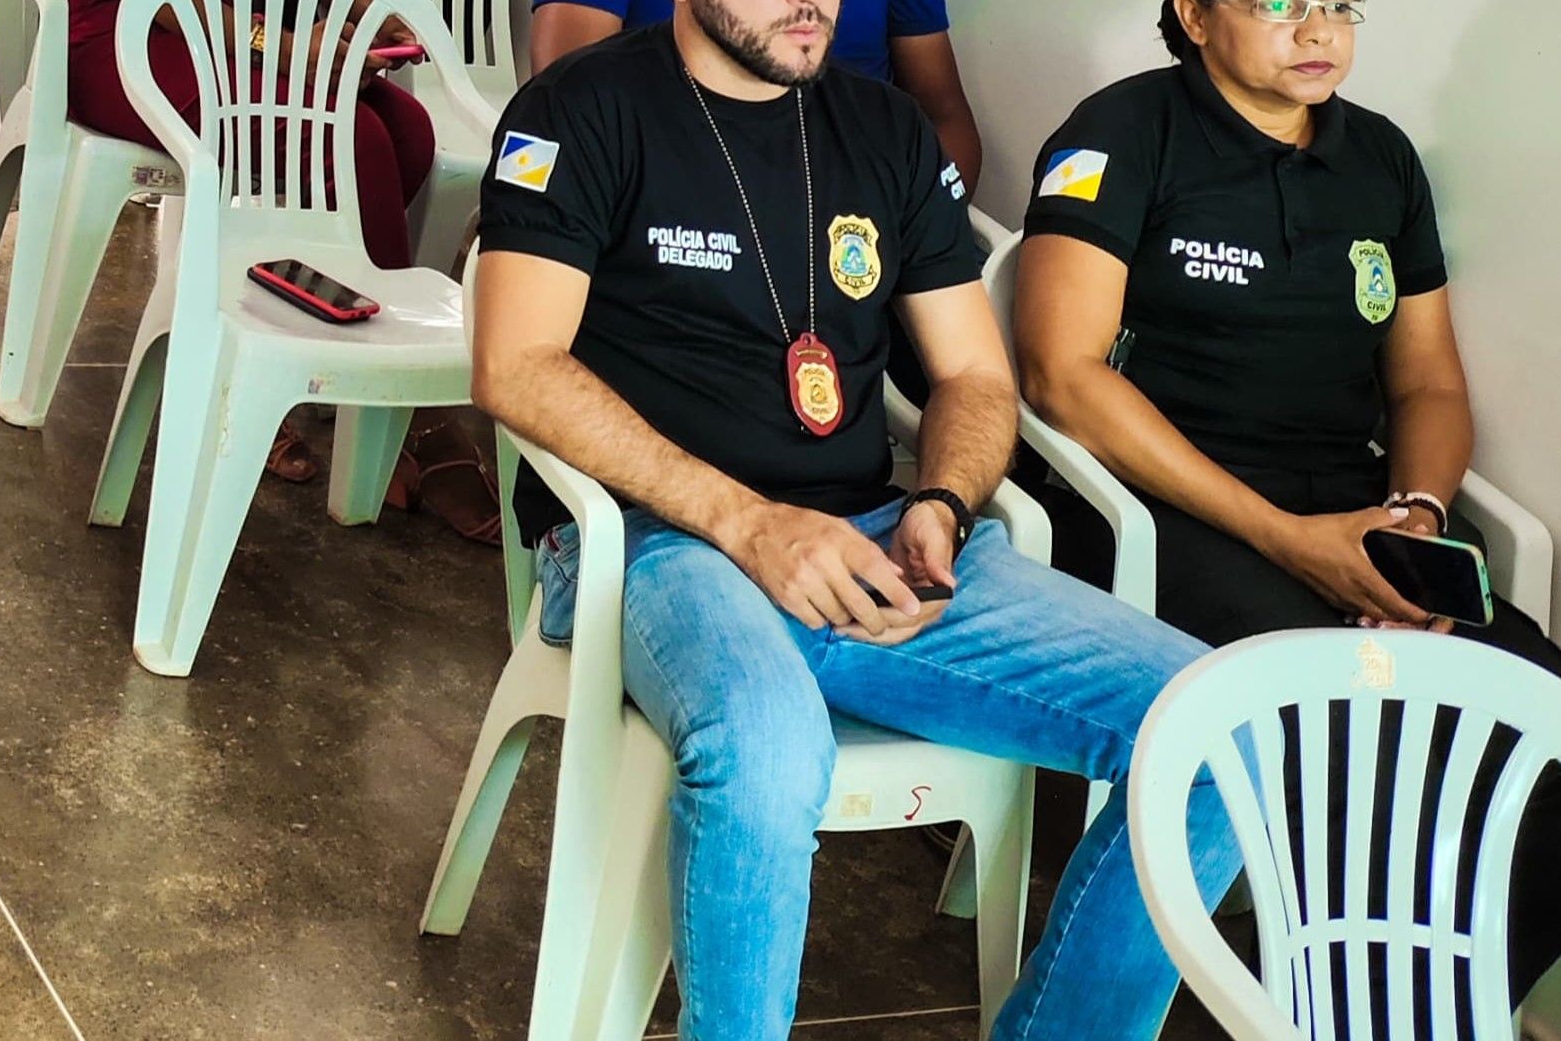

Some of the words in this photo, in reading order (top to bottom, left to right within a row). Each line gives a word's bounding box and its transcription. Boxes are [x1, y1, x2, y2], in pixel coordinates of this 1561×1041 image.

[648, 225, 705, 249] POLÍCIA
[707, 232, 742, 254] CIVIL
[658, 245, 733, 271] DELEGADO
[1170, 238, 1265, 269] POLÍCIA
[1184, 260, 1249, 285] CIVIL
